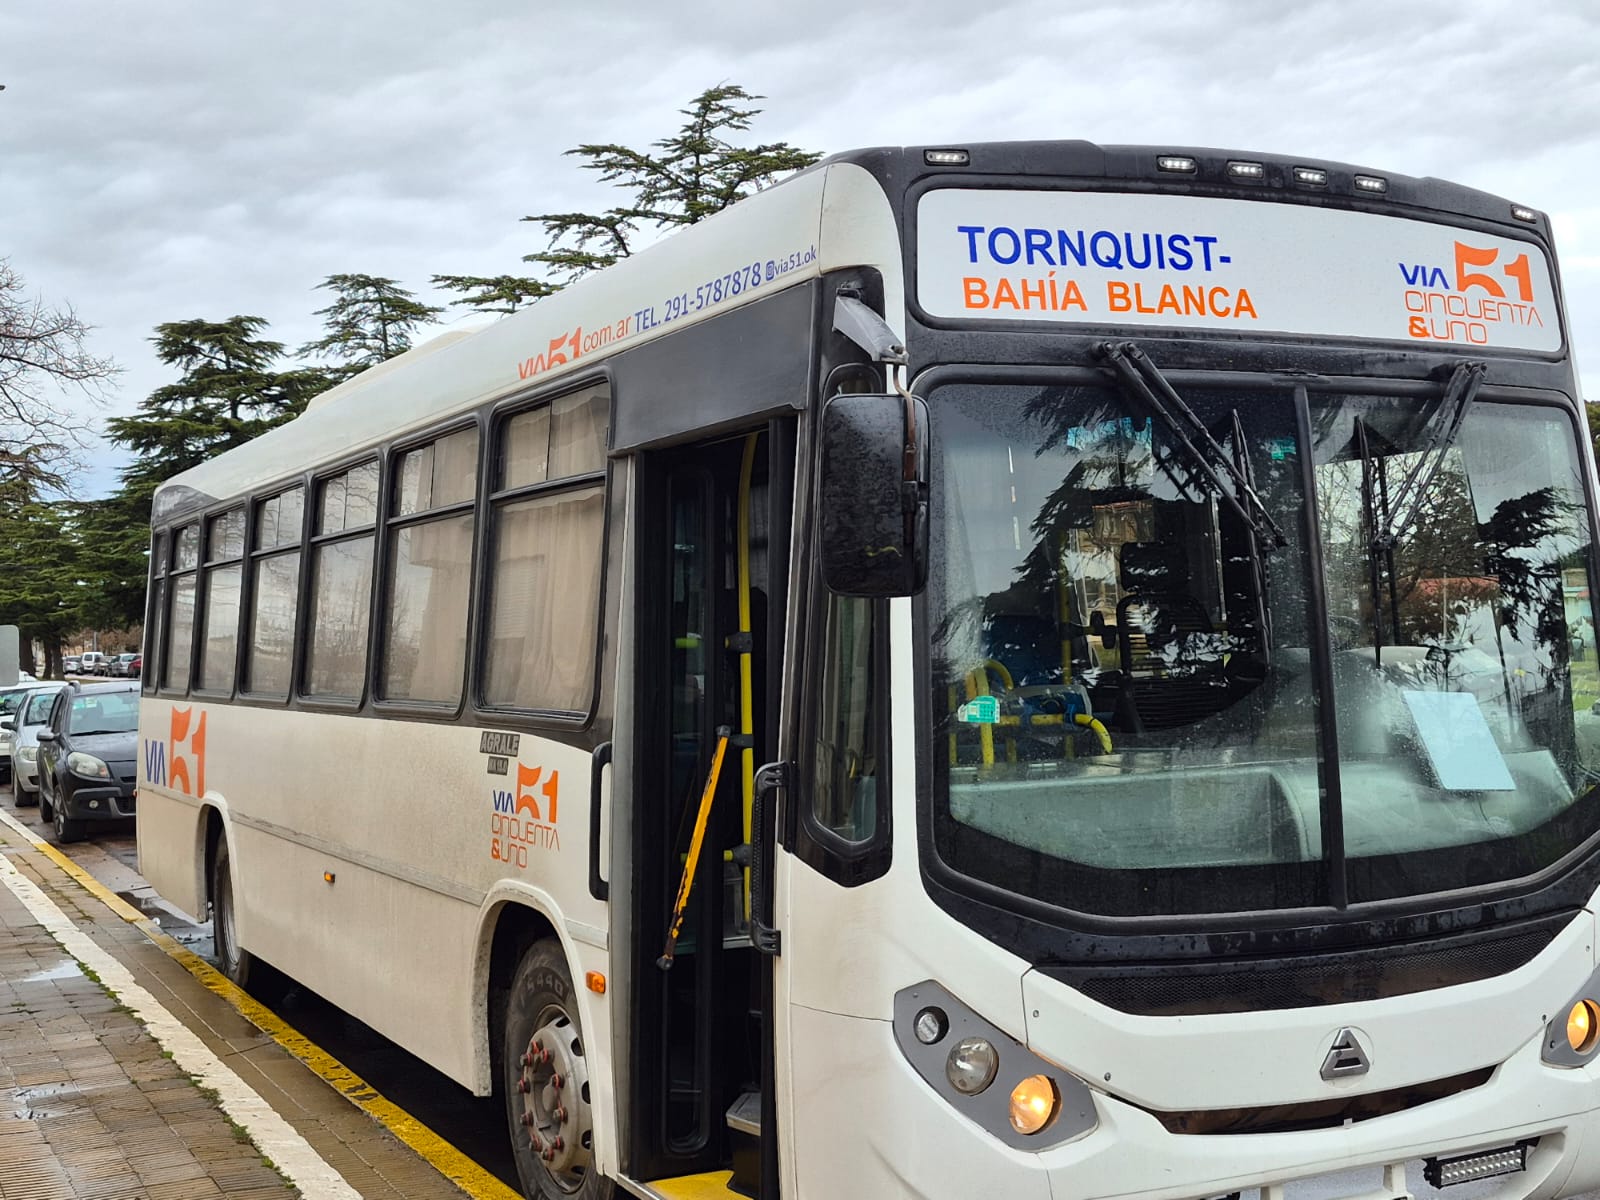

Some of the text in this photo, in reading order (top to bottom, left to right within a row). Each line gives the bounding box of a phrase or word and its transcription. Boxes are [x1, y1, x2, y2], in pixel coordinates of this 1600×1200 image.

[957, 225, 1232, 272] TORNQUIST-
[1398, 240, 1534, 303] VIA 51
[635, 310, 661, 333] TEL.
[664, 262, 762, 322] 291-5787878
[962, 270, 1259, 320] BAHÍA BLANCA
[145, 705, 207, 799] VIA 51
[480, 732, 519, 756] AGRALE
[493, 789, 515, 814] VIA
[515, 762, 559, 824] 51
